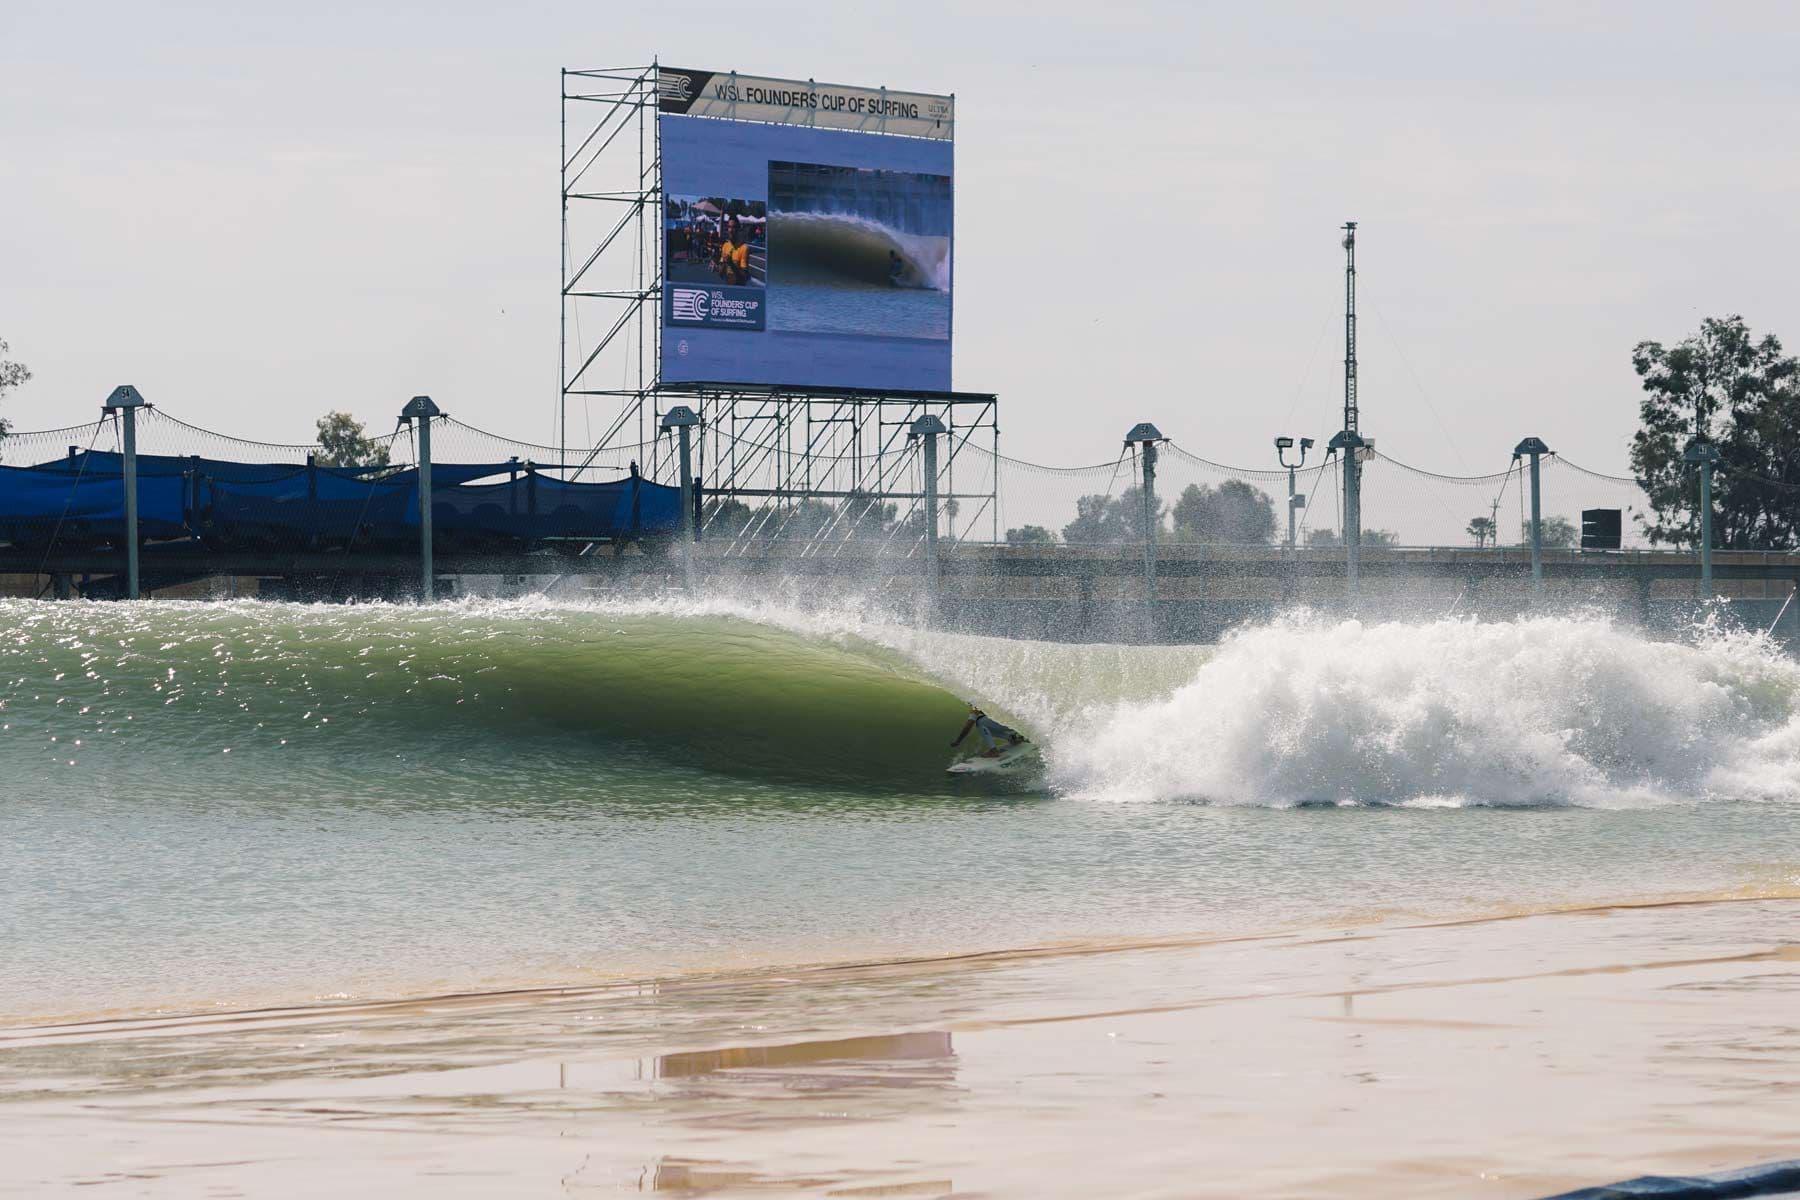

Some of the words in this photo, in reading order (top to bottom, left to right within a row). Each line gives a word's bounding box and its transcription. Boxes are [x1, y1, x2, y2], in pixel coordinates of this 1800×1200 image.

[715, 84, 744, 101] WSL
[747, 88, 820, 108] FOUNDERS'
[822, 95, 845, 111] CUP
[848, 97, 864, 112] OF
[868, 99, 918, 118] SURFING
[711, 291, 724, 299] WSL
[711, 308, 720, 316] OF
[720, 309, 747, 317] SURFING
[121, 387, 130, 399] 54
[677, 408, 686, 419] 52
[925, 416, 933, 427] 51
